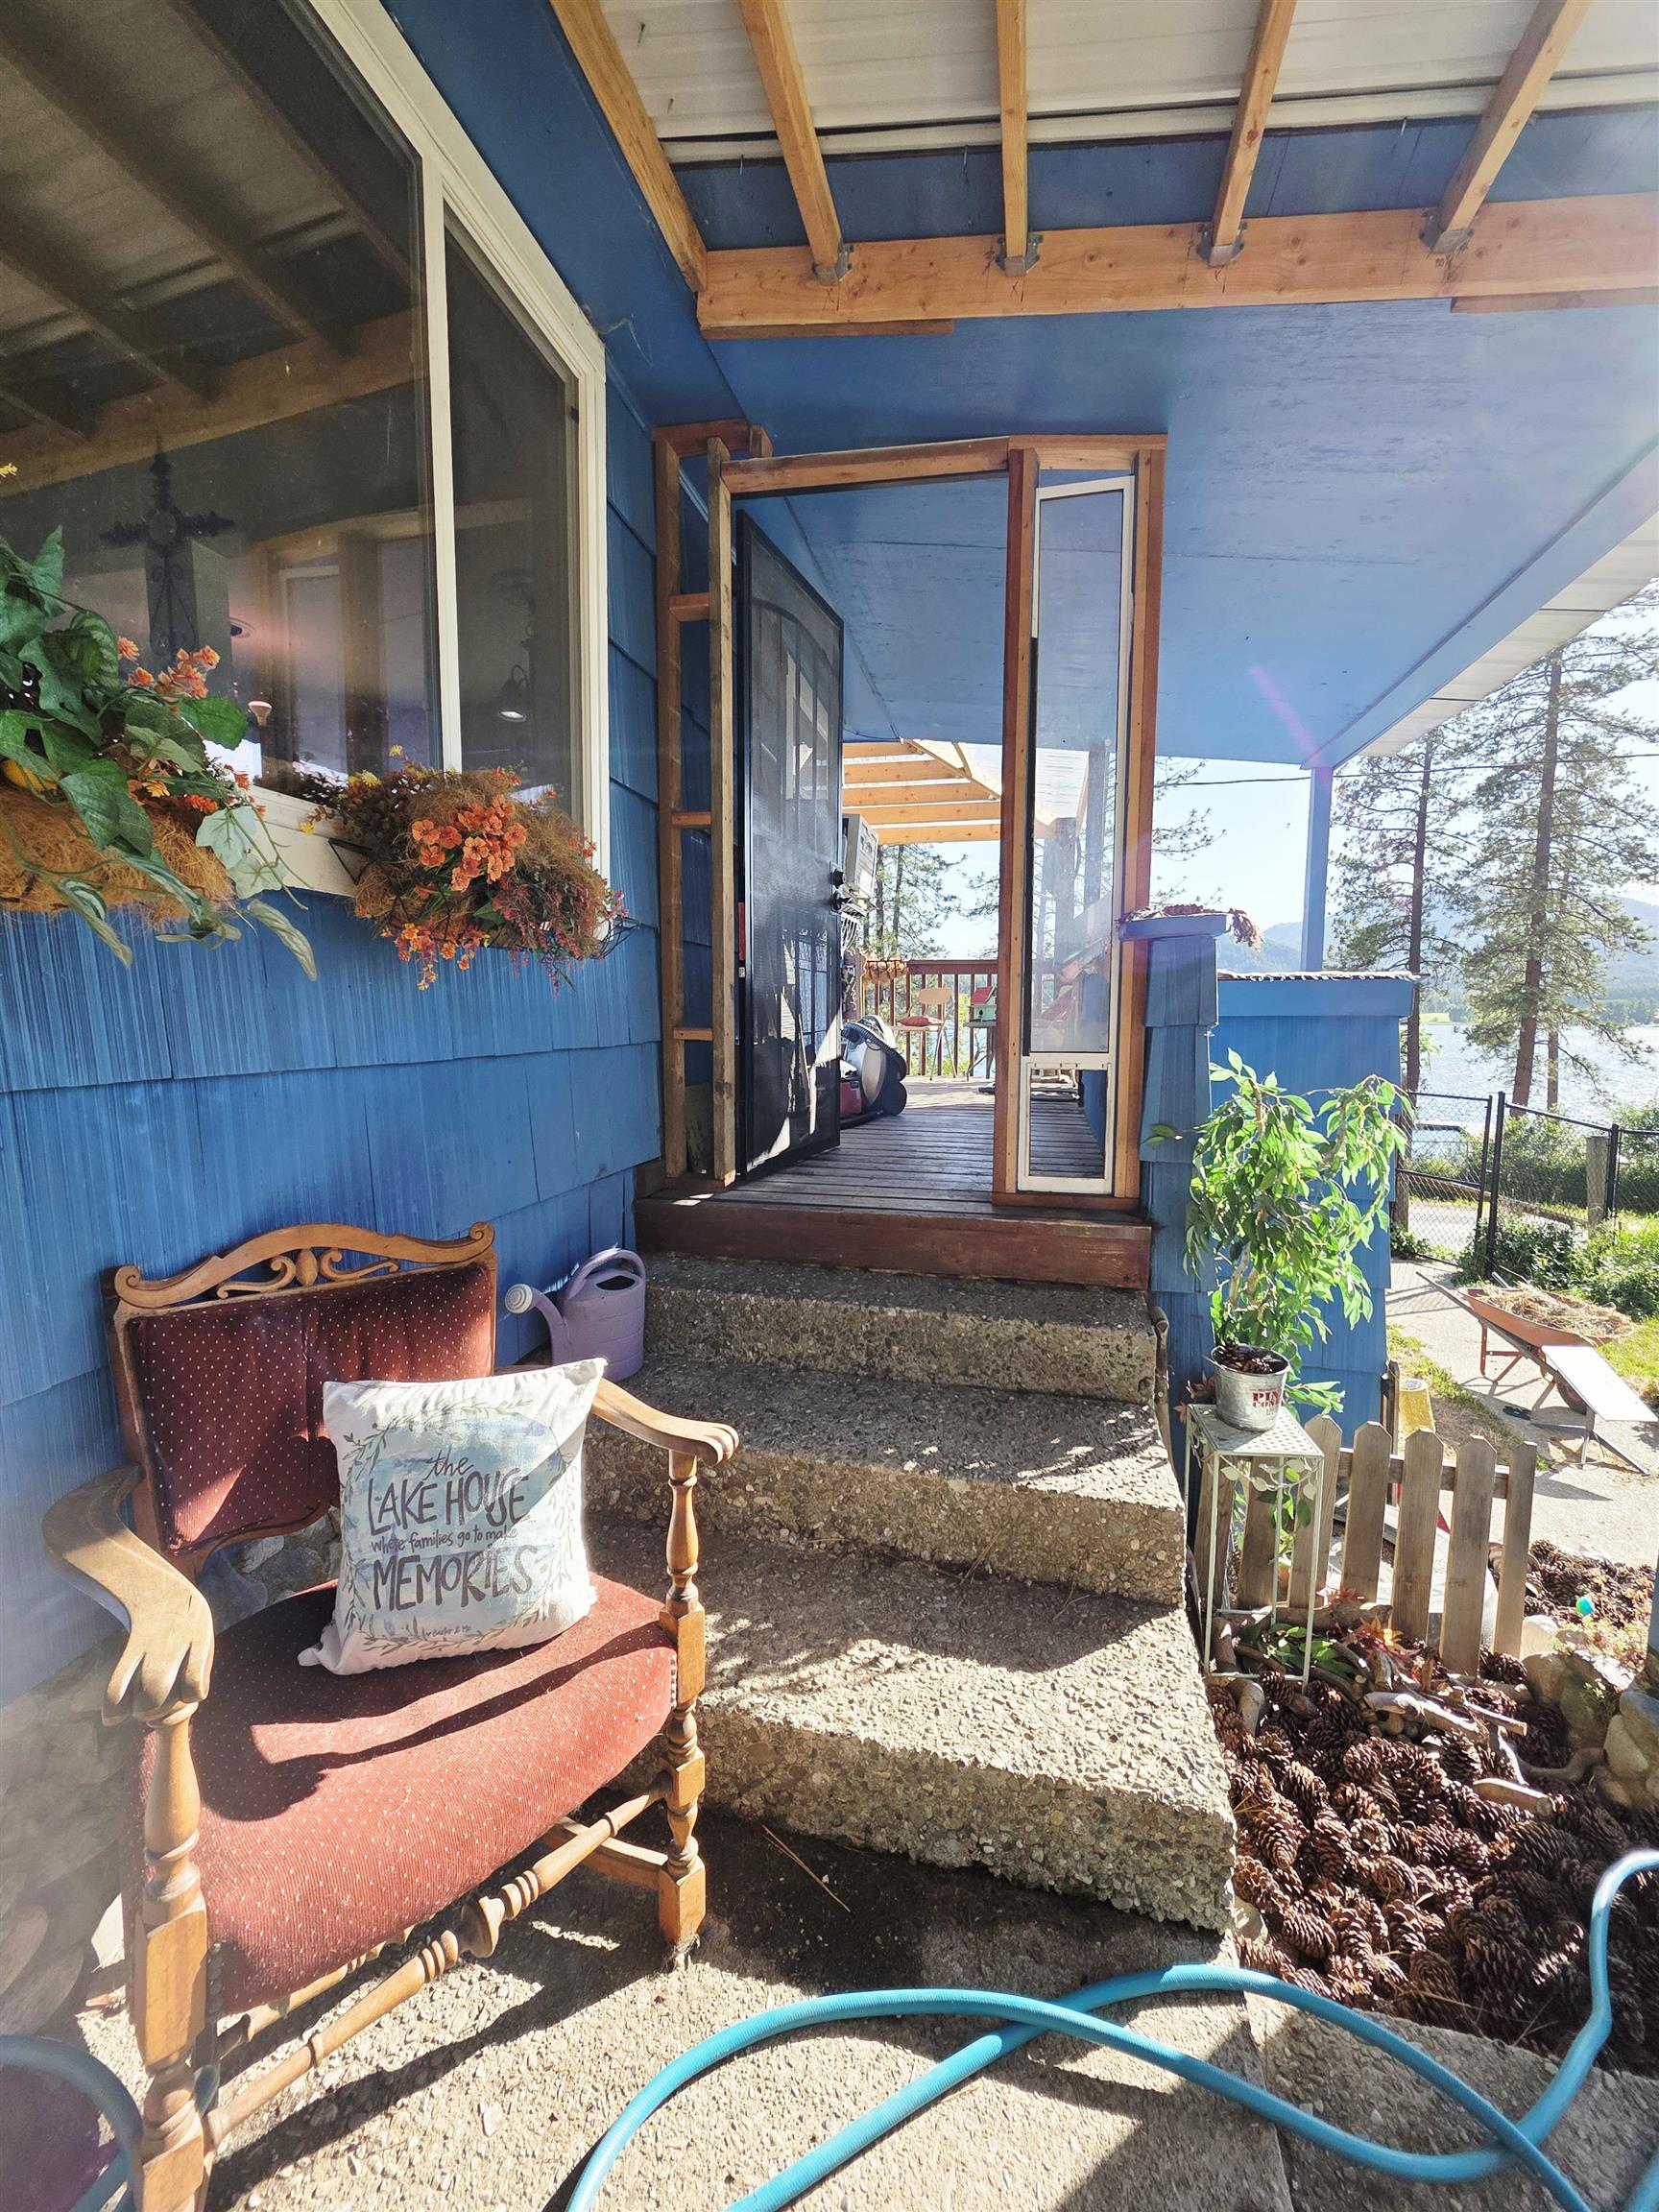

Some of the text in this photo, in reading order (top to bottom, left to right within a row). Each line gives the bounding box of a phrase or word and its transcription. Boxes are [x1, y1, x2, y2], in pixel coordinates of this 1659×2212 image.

[423, 1444, 473, 1480] the
[368, 1468, 529, 1535] LAKE HOUSE
[372, 1525, 517, 1553] where families go to make
[373, 1544, 539, 1611] MEMORIES
